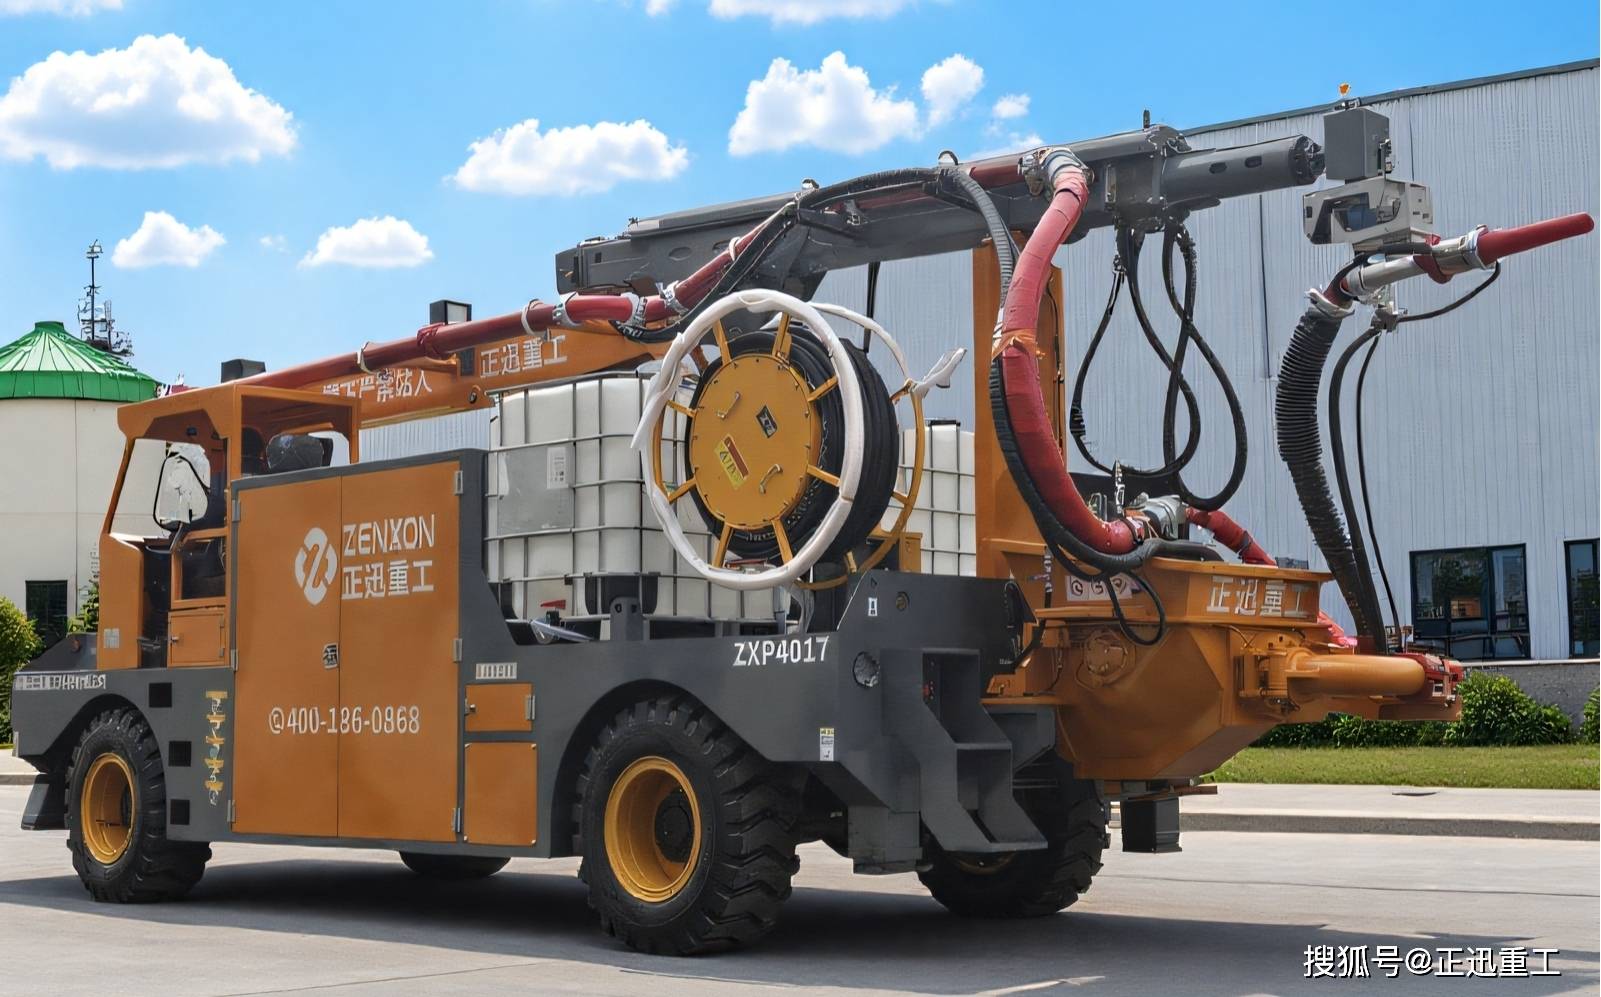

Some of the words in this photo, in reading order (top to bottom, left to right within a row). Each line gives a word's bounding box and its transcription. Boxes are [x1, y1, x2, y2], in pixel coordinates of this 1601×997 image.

[480, 335, 568, 378] 正迅重工
[342, 514, 435, 556] ZENXON
[341, 560, 434, 600] 正迅重工
[1206, 576, 1313, 618] 正迅重工
[733, 635, 829, 666] ZXP4017
